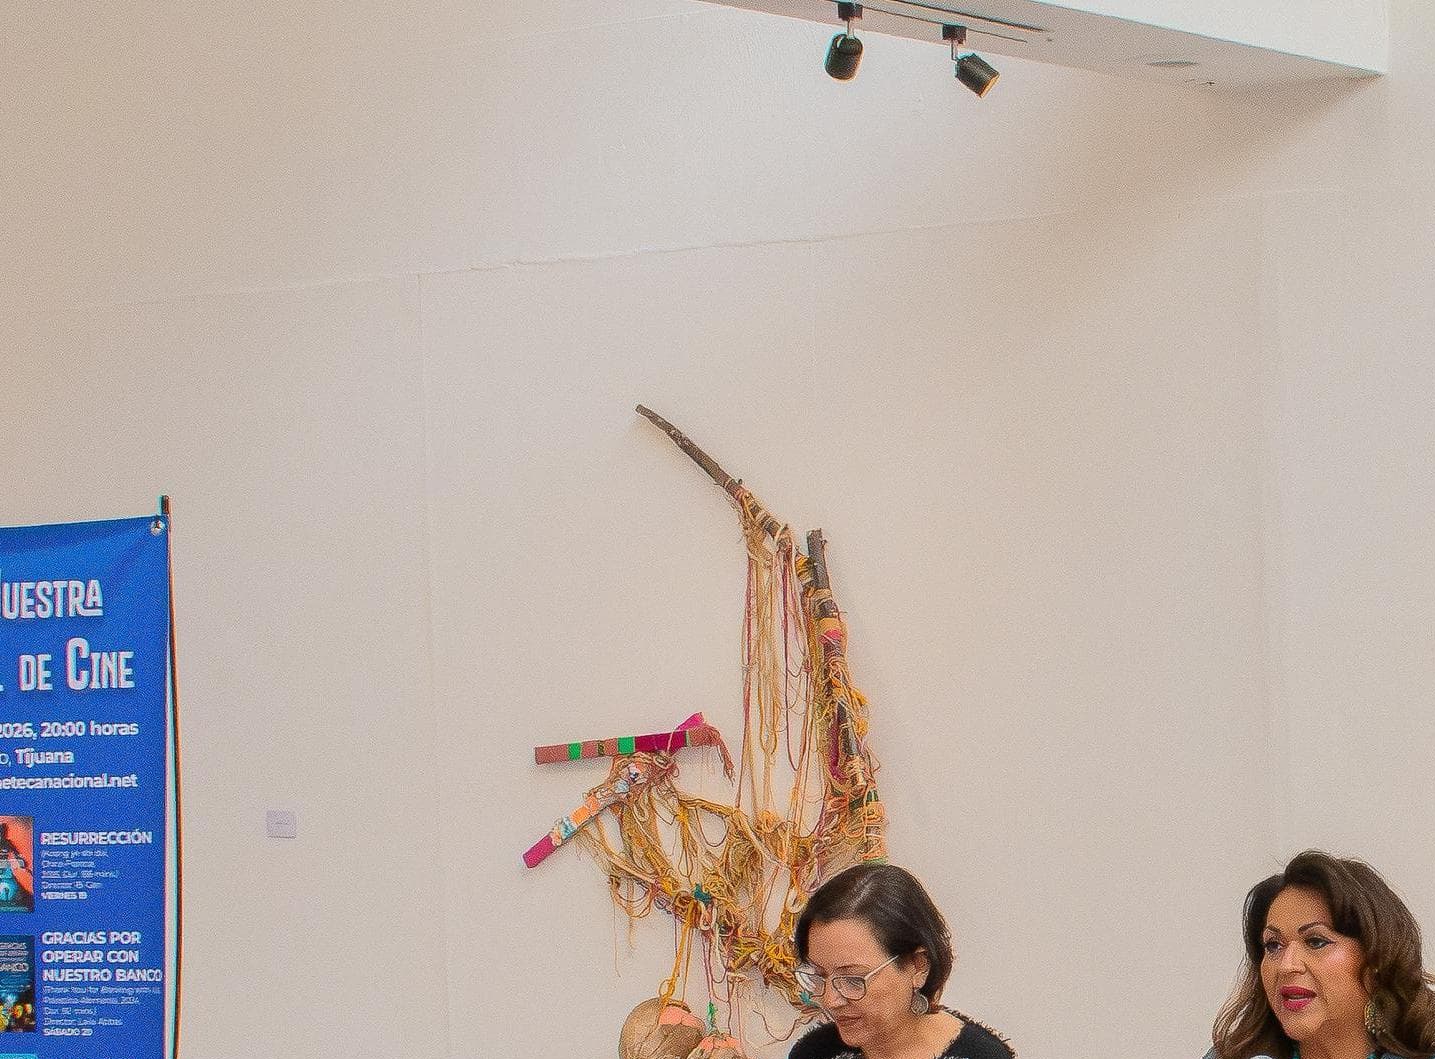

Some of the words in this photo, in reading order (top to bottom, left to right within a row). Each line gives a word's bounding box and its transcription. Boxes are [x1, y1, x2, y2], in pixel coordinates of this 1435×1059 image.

[19, 653, 53, 691] DE
[66, 637, 135, 691] CINE
[41, 720, 86, 736] 20:00
[90, 720, 139, 736] horas
[15, 747, 75, 768] Tijuana
[41, 829, 152, 846] RESURRECCIÓN
[42, 931, 107, 945] GRACIAS
[109, 931, 142, 945] POR
[42, 949, 104, 963] OPERAR
[107, 949, 140, 963] CON
[42, 968, 112, 982] NUESTRO
[116, 968, 162, 982] BANCO
